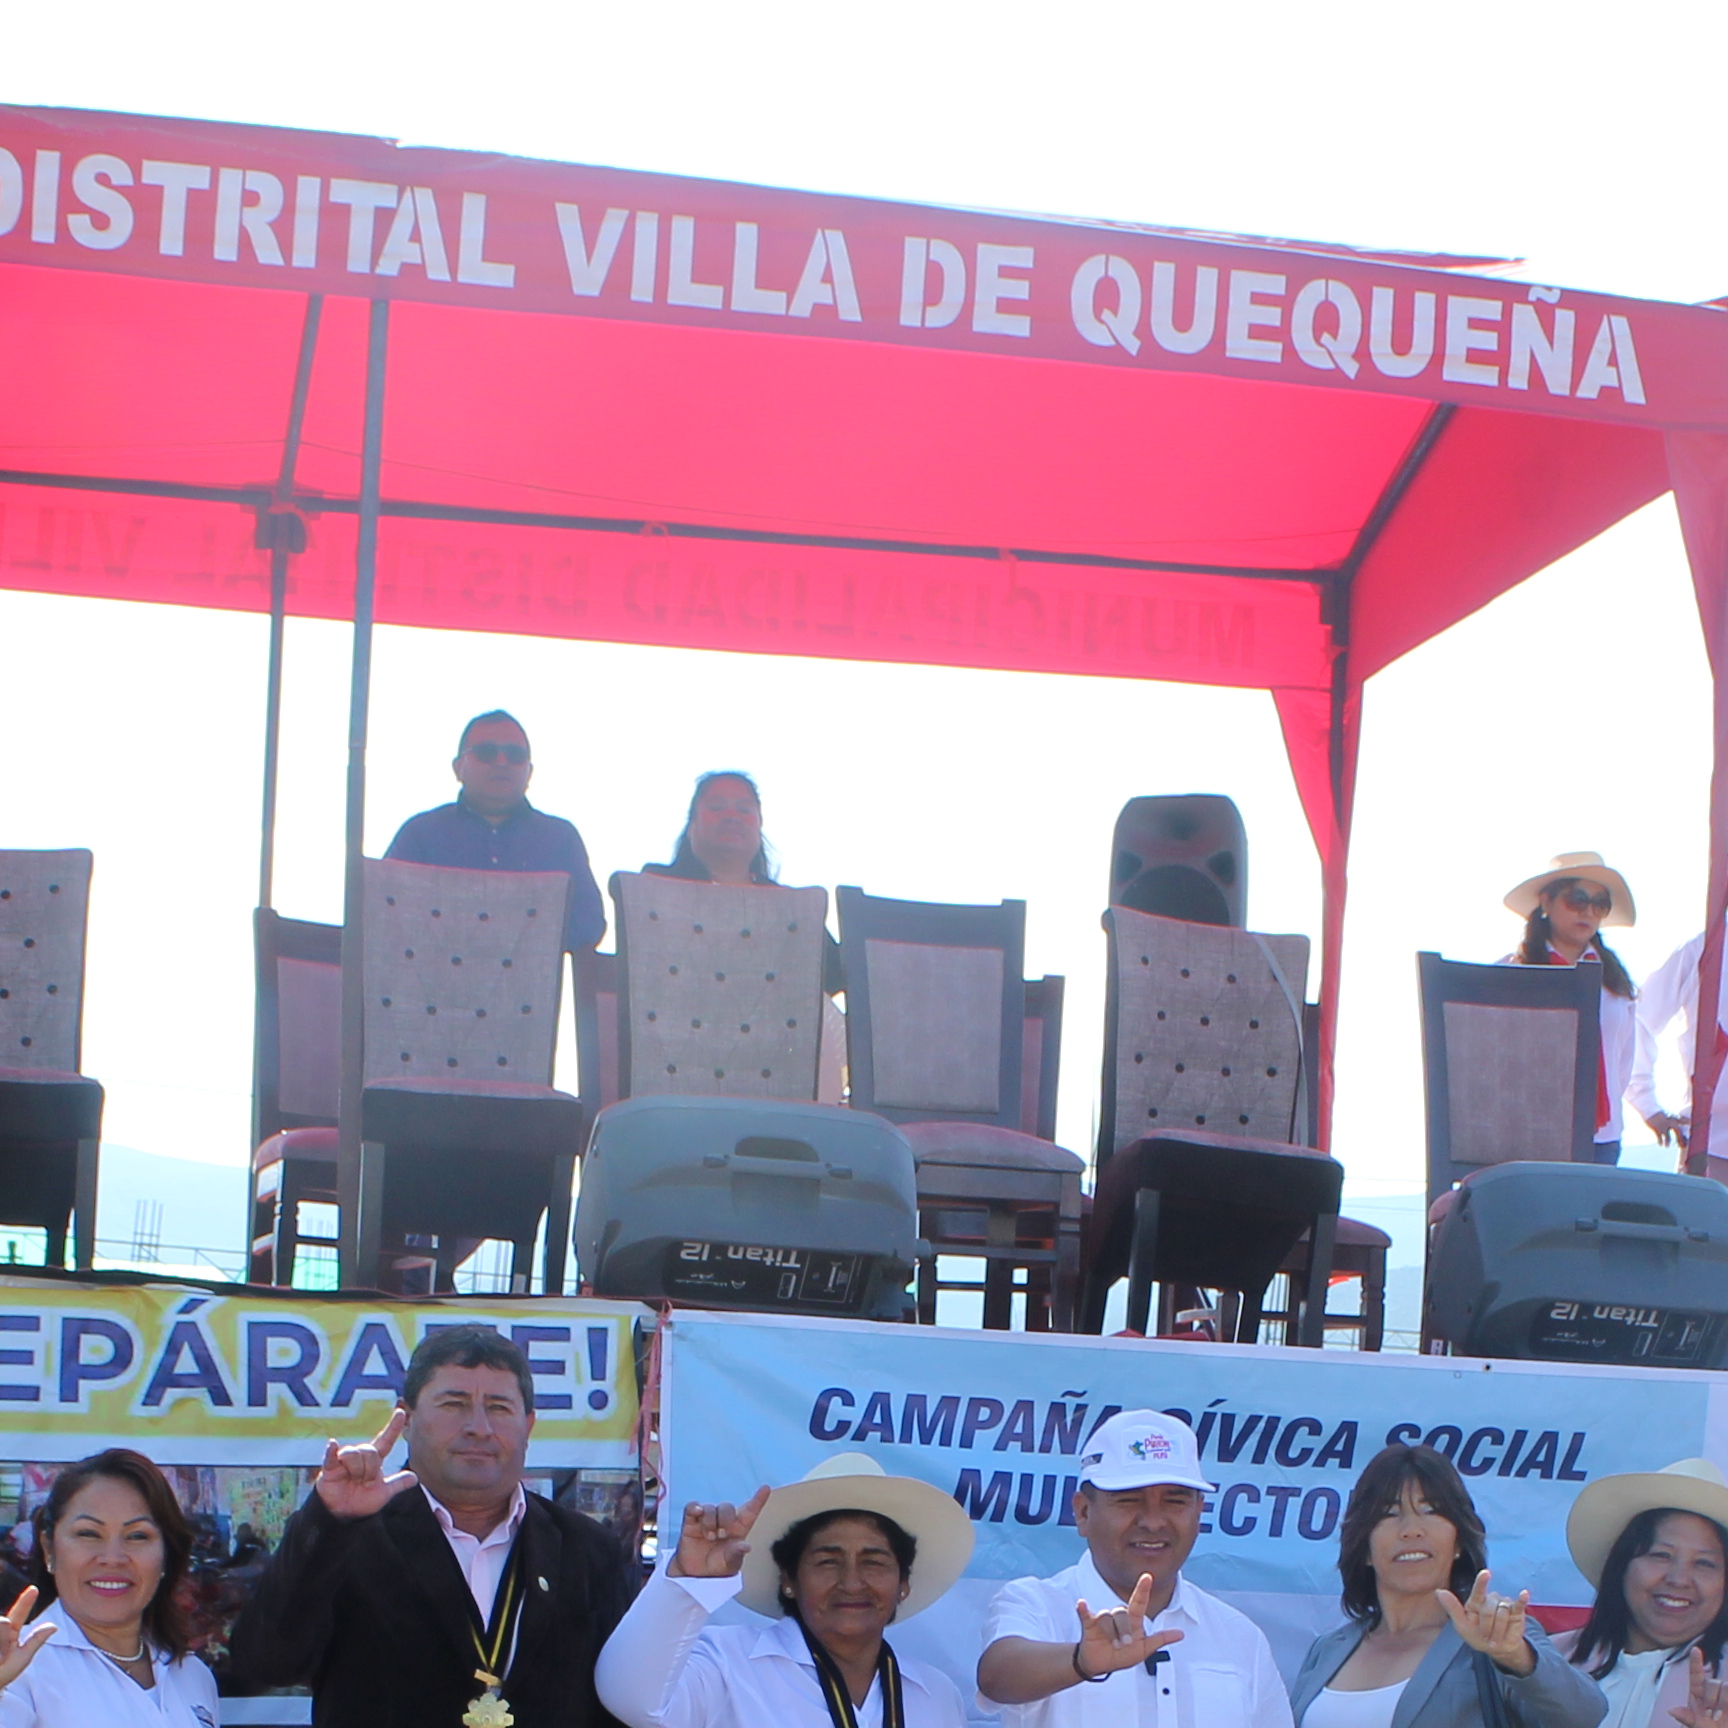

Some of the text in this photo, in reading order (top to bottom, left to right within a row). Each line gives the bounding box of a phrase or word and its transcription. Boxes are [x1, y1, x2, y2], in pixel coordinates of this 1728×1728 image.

[555, 200, 863, 323] VILLA
[899, 236, 1033, 339] DE
[1071, 252, 1647, 406] QUEQUEÑA
[727, 1245, 801, 1269] Titan
[1592, 1304, 1660, 1328] Titan
[808, 1387, 1123, 1458] CAMPAÑ
[1166, 1398, 1359, 1470] ÍVICA
